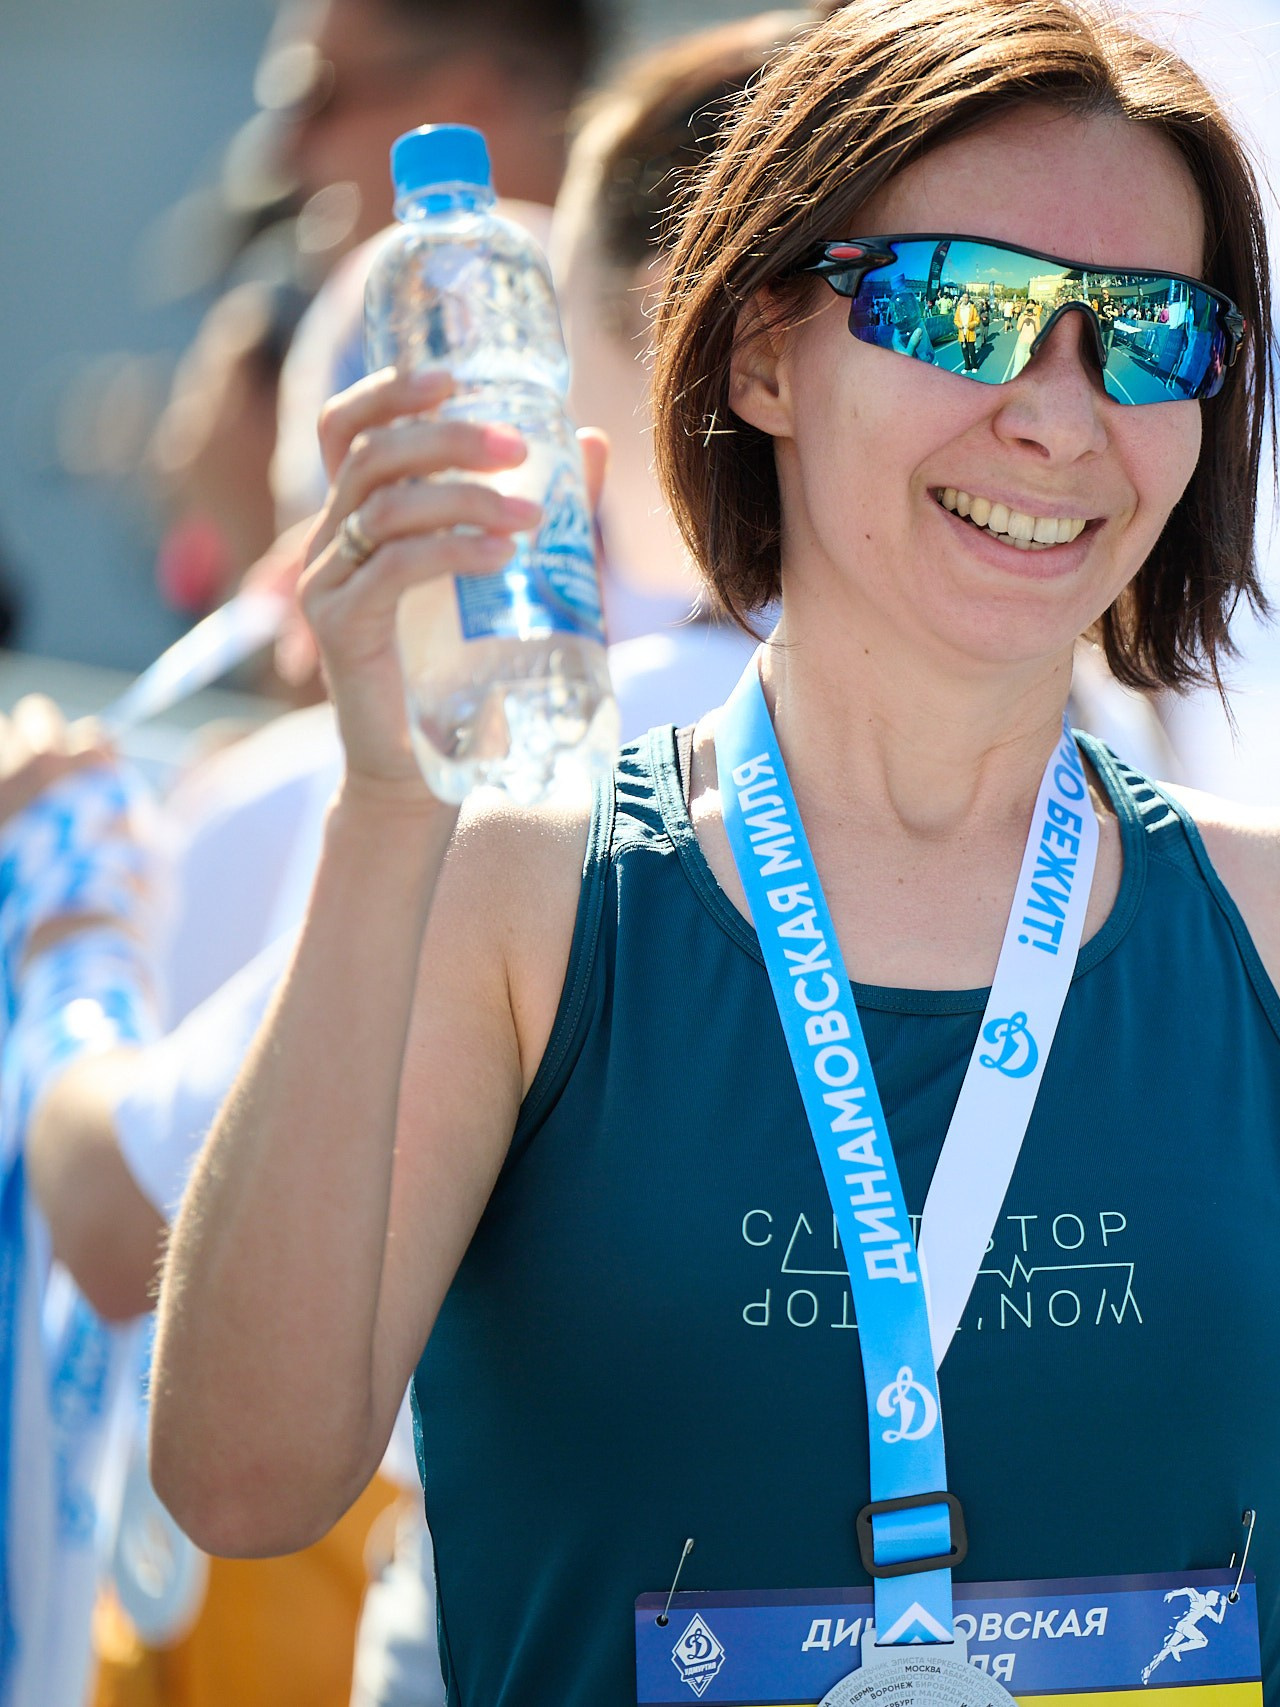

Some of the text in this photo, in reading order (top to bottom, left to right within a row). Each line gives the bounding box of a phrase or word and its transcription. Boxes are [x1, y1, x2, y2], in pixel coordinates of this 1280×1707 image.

[1018, 798, 1083, 956] БЕЖИТ!
[732, 752, 917, 1284] ДИНАМОВСКАЯ МИЛЯ
[985, 1211, 1127, 1253] TOP
[742, 1288, 1143, 1331] WON' TOP
[801, 1607, 1109, 1652] ДИОВСКАЯ
[890, 1656, 924, 1666] ЭЛИСТА
[904, 1665, 941, 1674] МОСКВА
[848, 1684, 874, 1705] ПЕРМЬ
[869, 1680, 912, 1700] ВОРОНЕЖ
